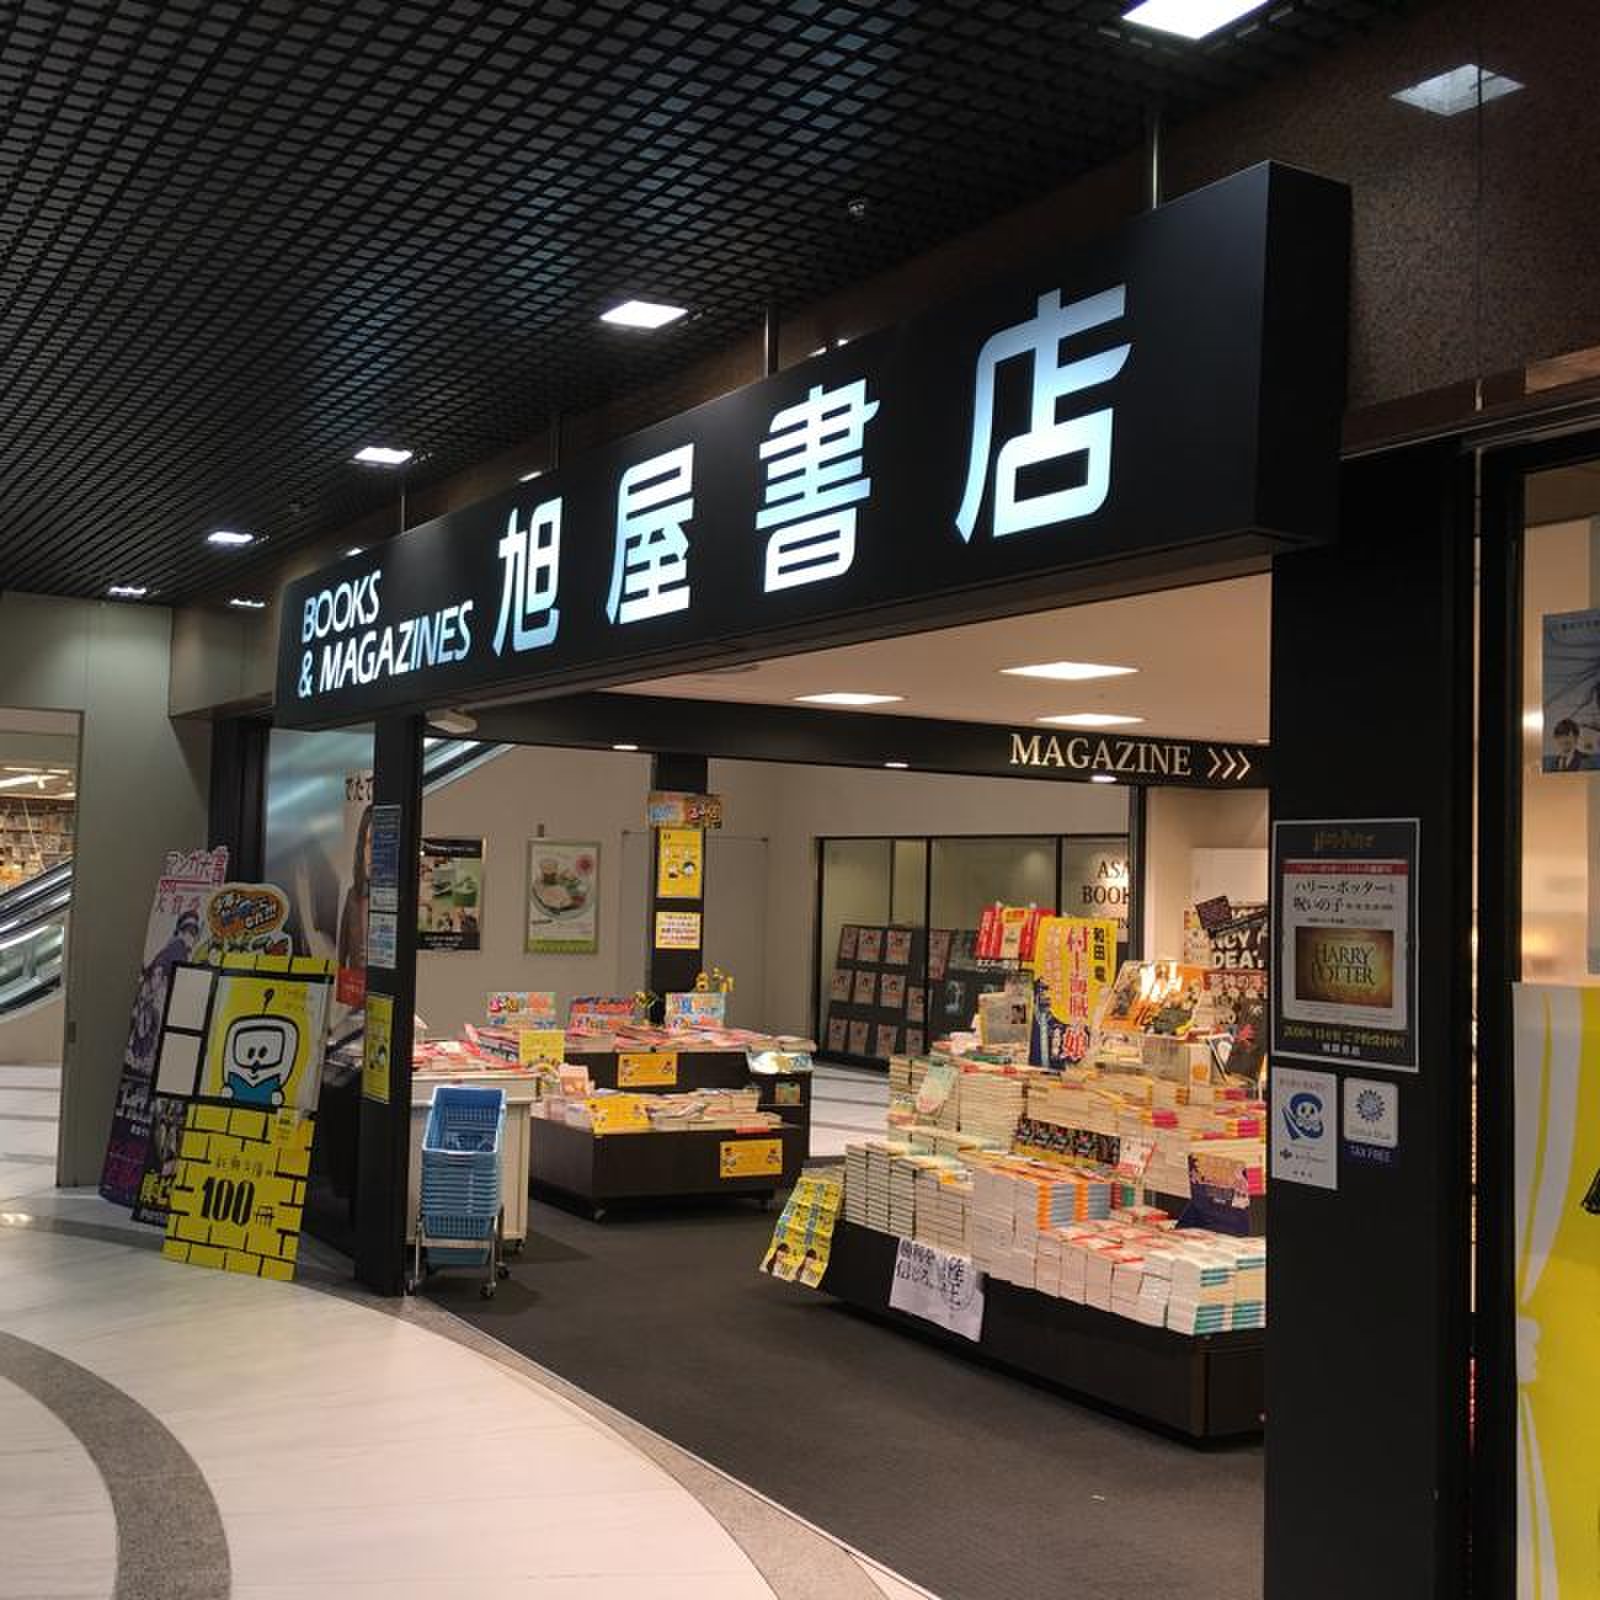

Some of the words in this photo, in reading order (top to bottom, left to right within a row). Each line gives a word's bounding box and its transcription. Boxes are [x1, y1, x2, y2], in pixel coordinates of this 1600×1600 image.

[493, 283, 1132, 656] 旭屋書店
[301, 570, 381, 643] BOOKS
[299, 651, 313, 698] &
[319, 600, 474, 692] MAGAZINES
[1010, 733, 1192, 776] MAGAZINE
[1314, 944, 1376, 965] HARRY
